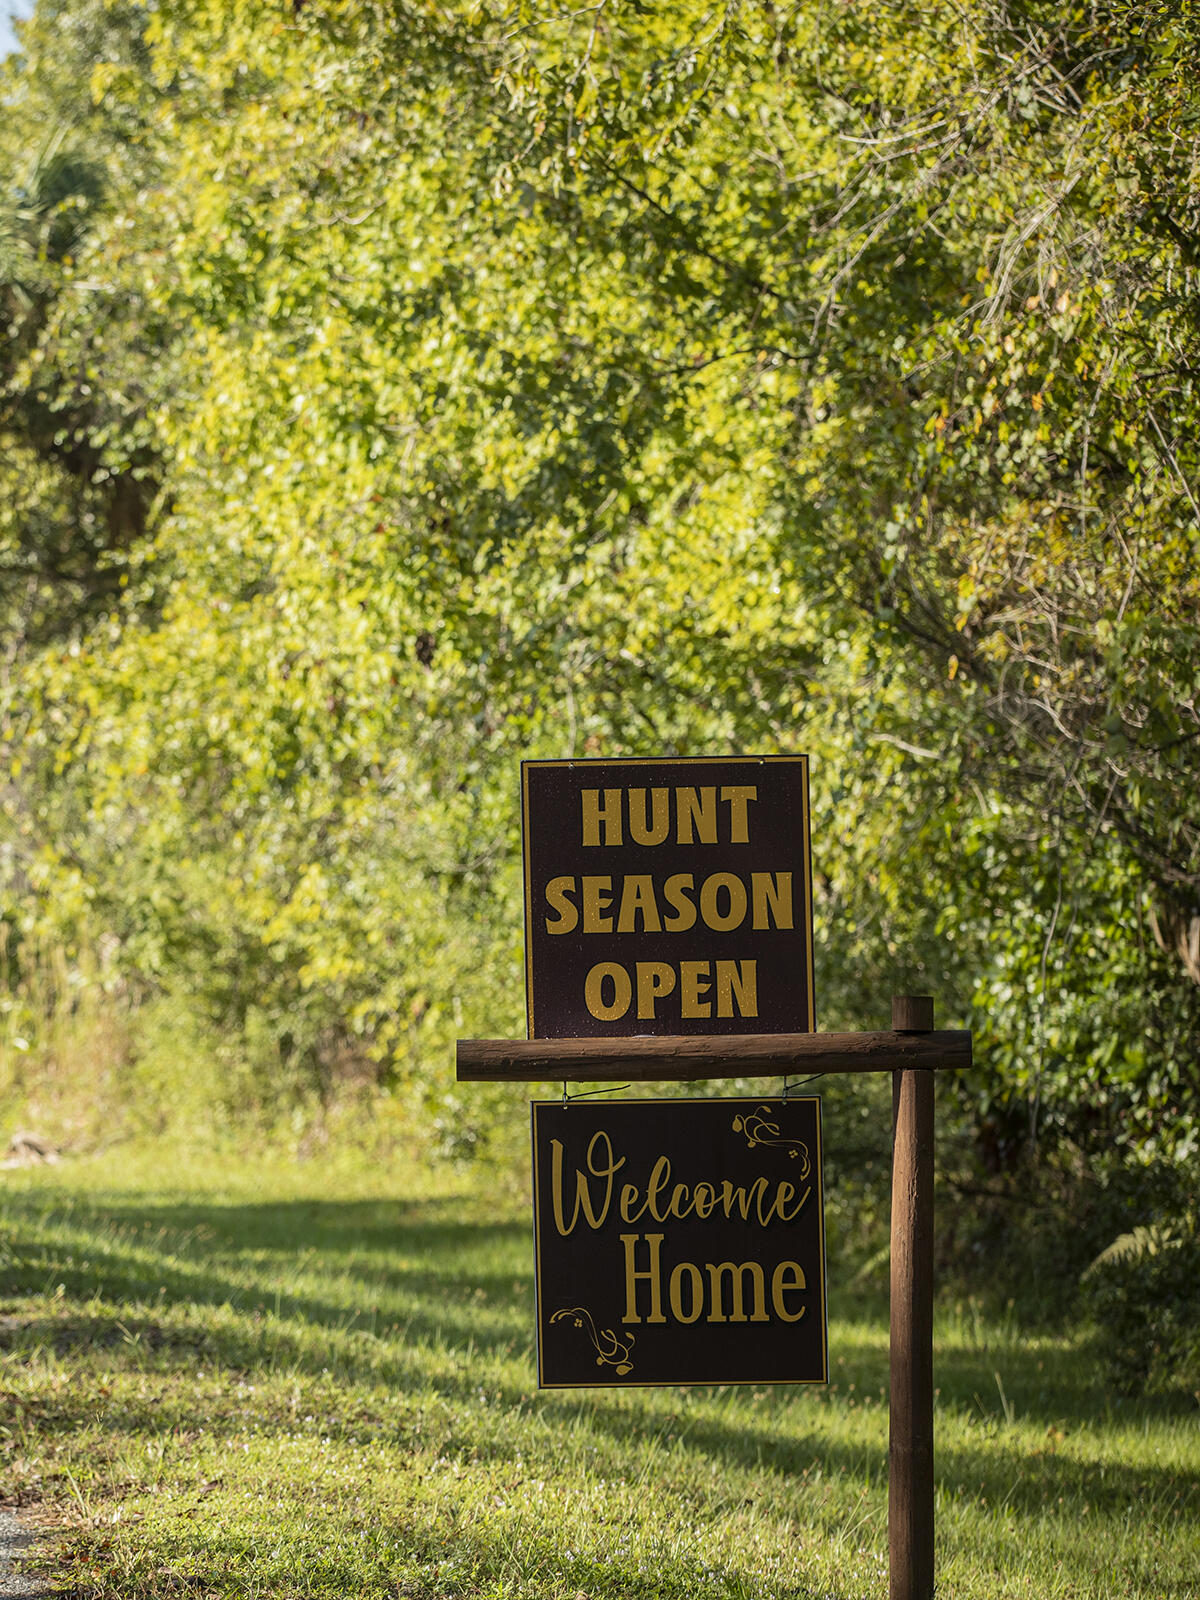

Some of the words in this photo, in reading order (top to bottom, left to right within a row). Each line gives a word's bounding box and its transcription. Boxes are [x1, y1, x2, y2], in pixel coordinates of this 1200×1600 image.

[580, 785, 758, 847] HUNT
[544, 871, 795, 935] SEASON
[584, 959, 759, 1022] OPEN
[549, 1130, 811, 1236] Welcome
[619, 1232, 807, 1325] Home
